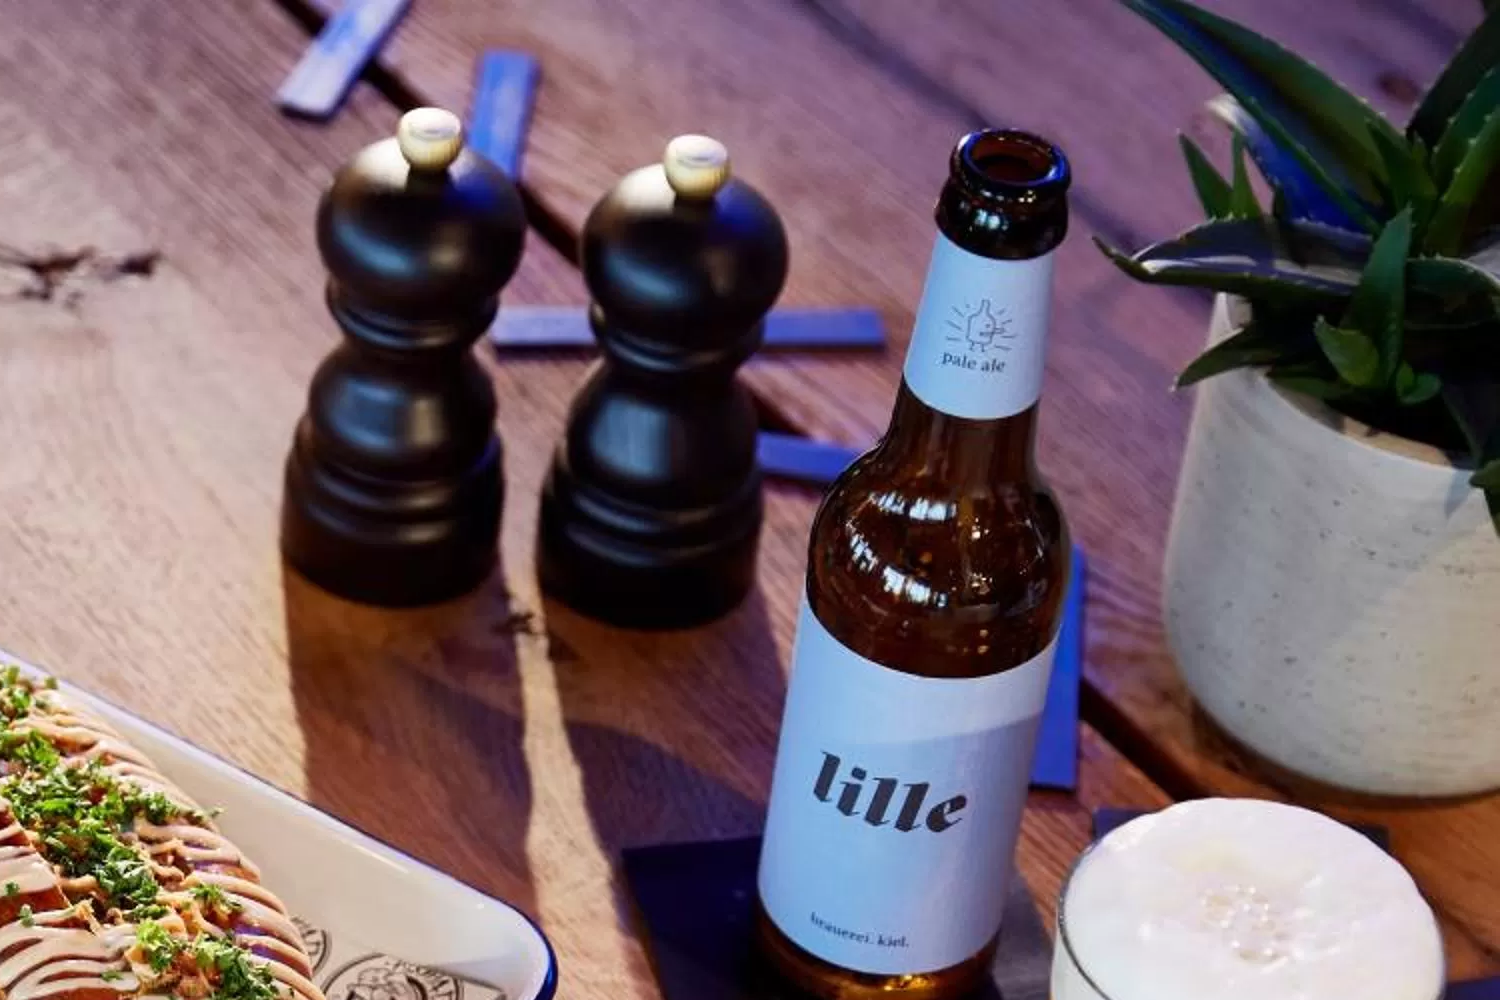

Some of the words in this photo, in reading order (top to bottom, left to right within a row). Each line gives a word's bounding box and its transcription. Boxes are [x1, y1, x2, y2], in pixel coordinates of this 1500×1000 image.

[941, 352, 977, 370] pale
[980, 358, 1006, 373] ale
[813, 749, 968, 833] lille
